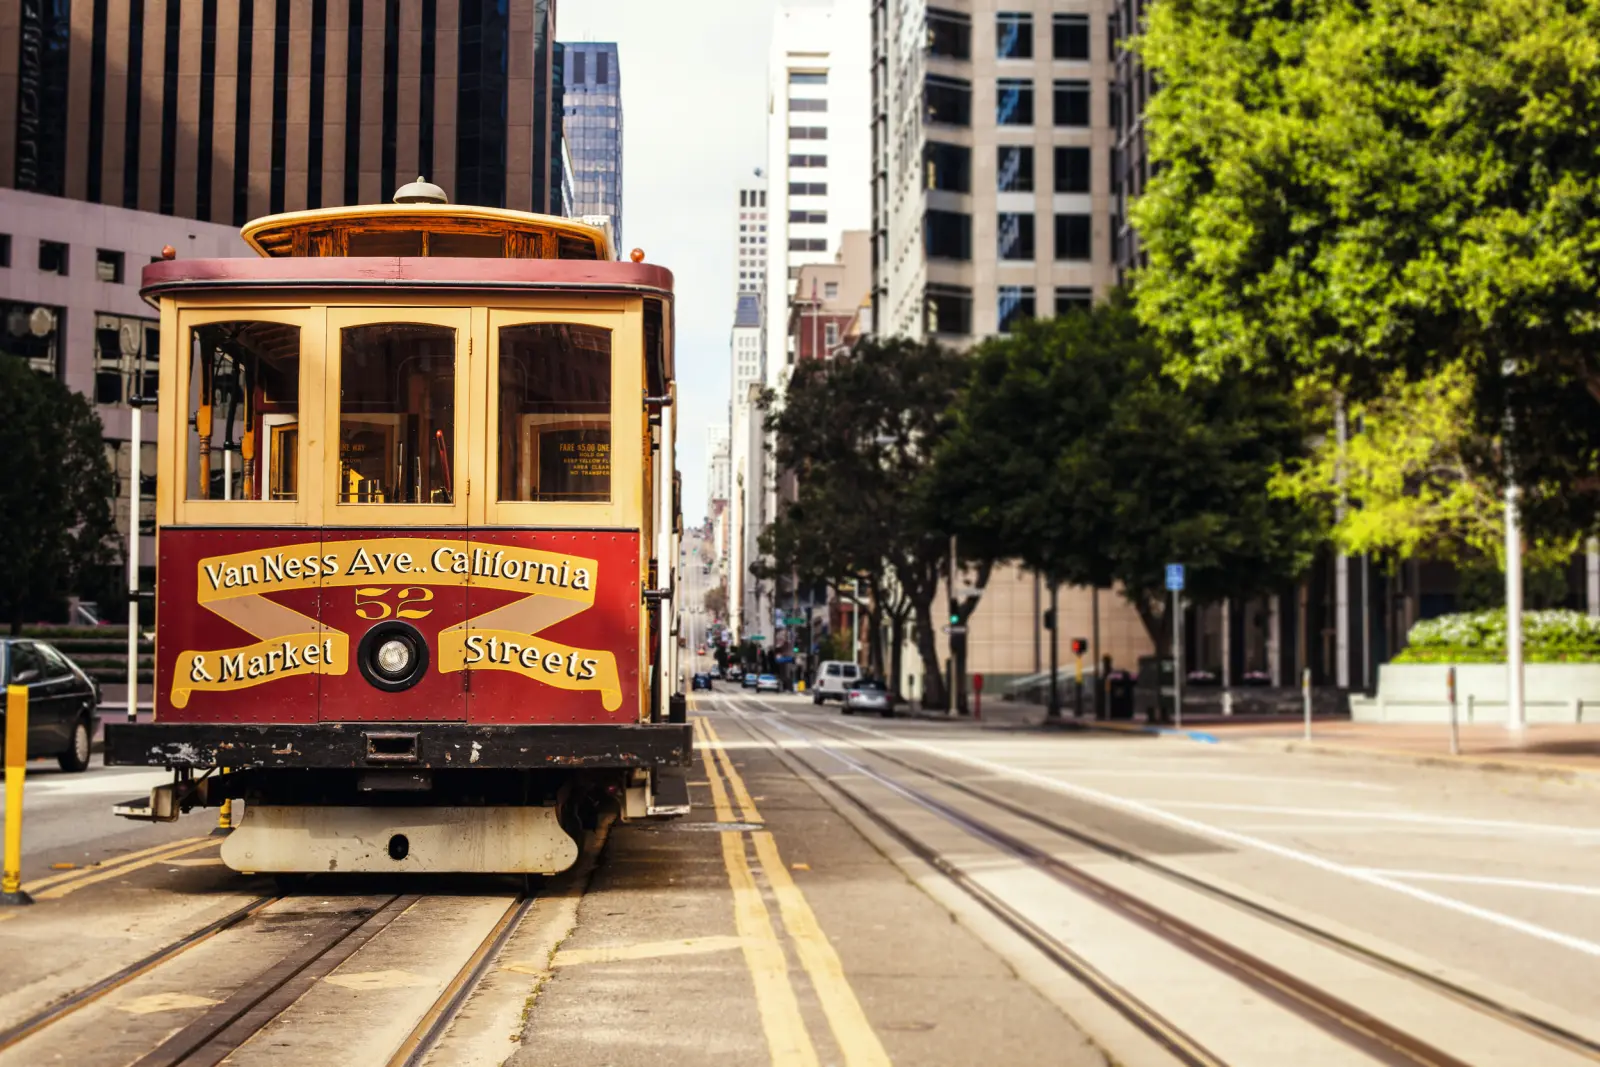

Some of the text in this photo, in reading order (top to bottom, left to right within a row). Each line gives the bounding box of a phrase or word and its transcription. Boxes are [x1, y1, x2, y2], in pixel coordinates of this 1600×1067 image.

[431, 547, 591, 591] California
[354, 587, 434, 620] 52
[190, 638, 332, 683] & Market
[465, 635, 598, 681] Streets
